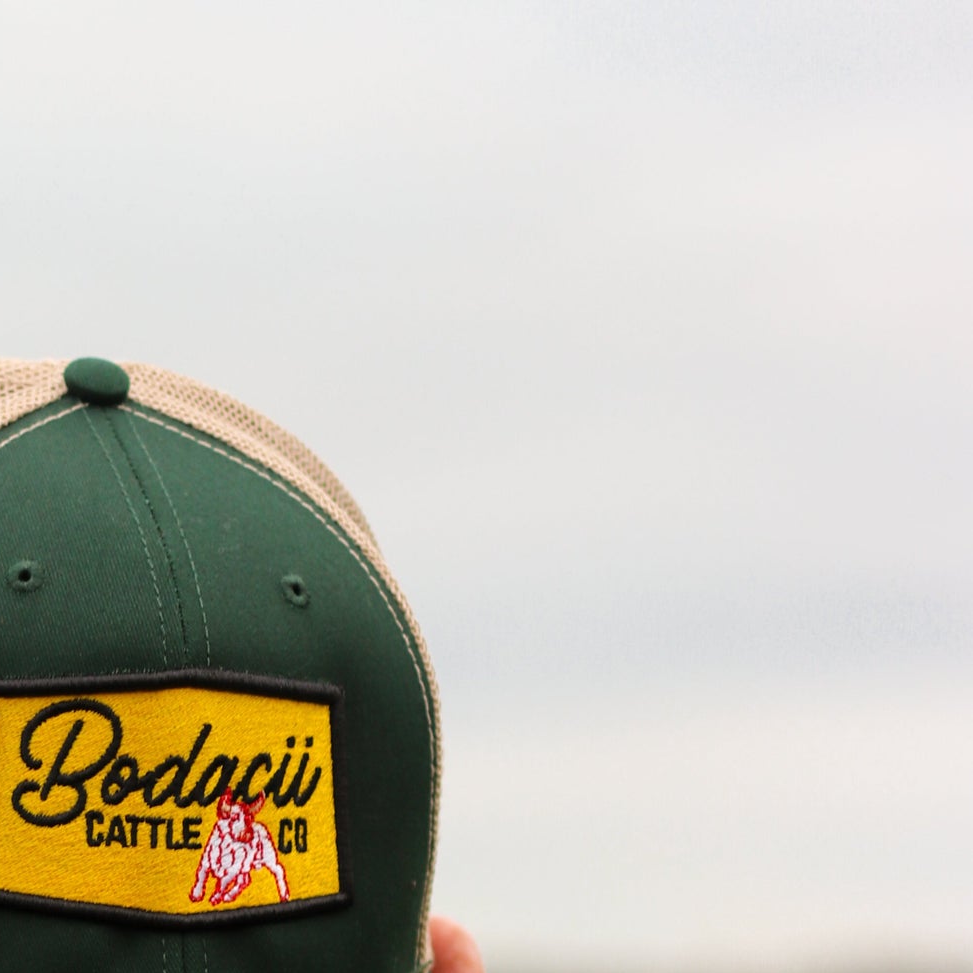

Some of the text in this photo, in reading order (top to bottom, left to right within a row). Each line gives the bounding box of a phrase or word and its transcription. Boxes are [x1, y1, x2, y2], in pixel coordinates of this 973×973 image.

[12, 699, 322, 827] Bodacii
[85, 810, 308, 854] CATTLE CO
